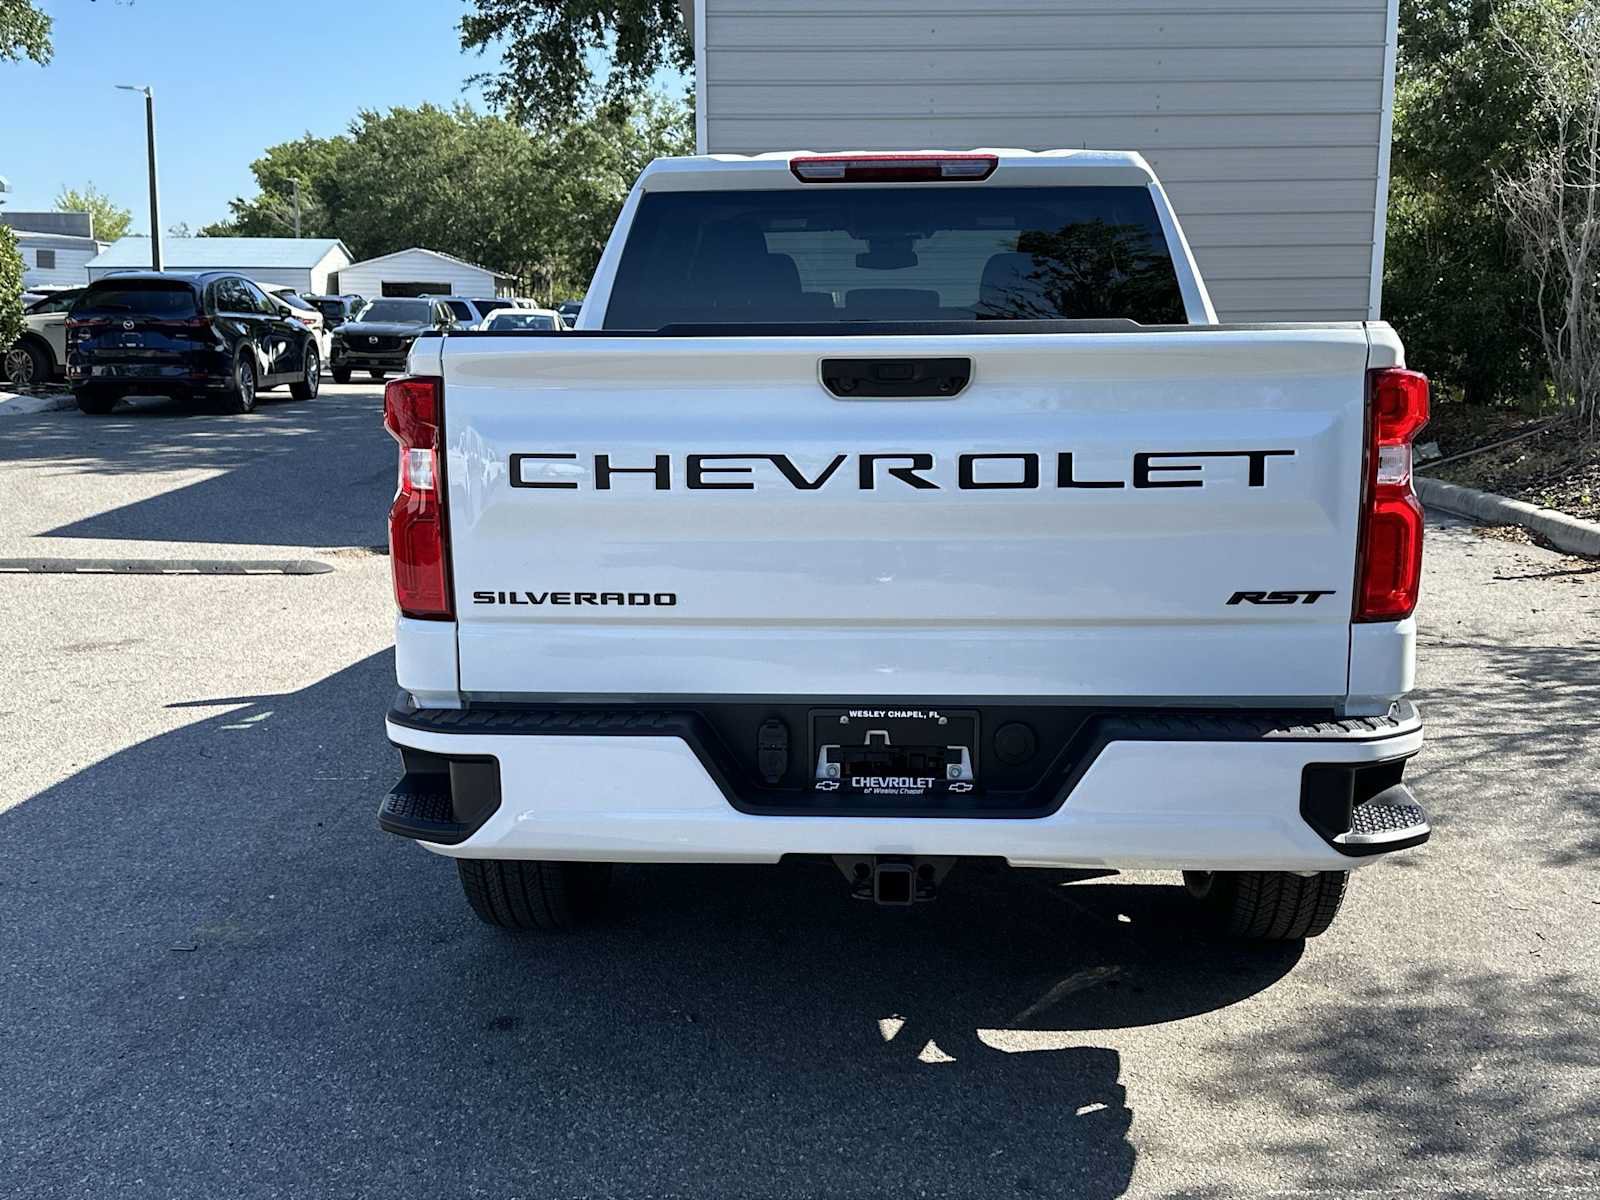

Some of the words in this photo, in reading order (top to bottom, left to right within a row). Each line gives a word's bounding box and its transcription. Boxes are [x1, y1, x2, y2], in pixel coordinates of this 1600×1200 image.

[508, 450, 1295, 491] CHEVROLET
[473, 591, 677, 606] SILVERADO
[1226, 590, 1336, 605] RST
[888, 711, 927, 719] CHAPEL,
[852, 777, 935, 788] CHEVROLET
